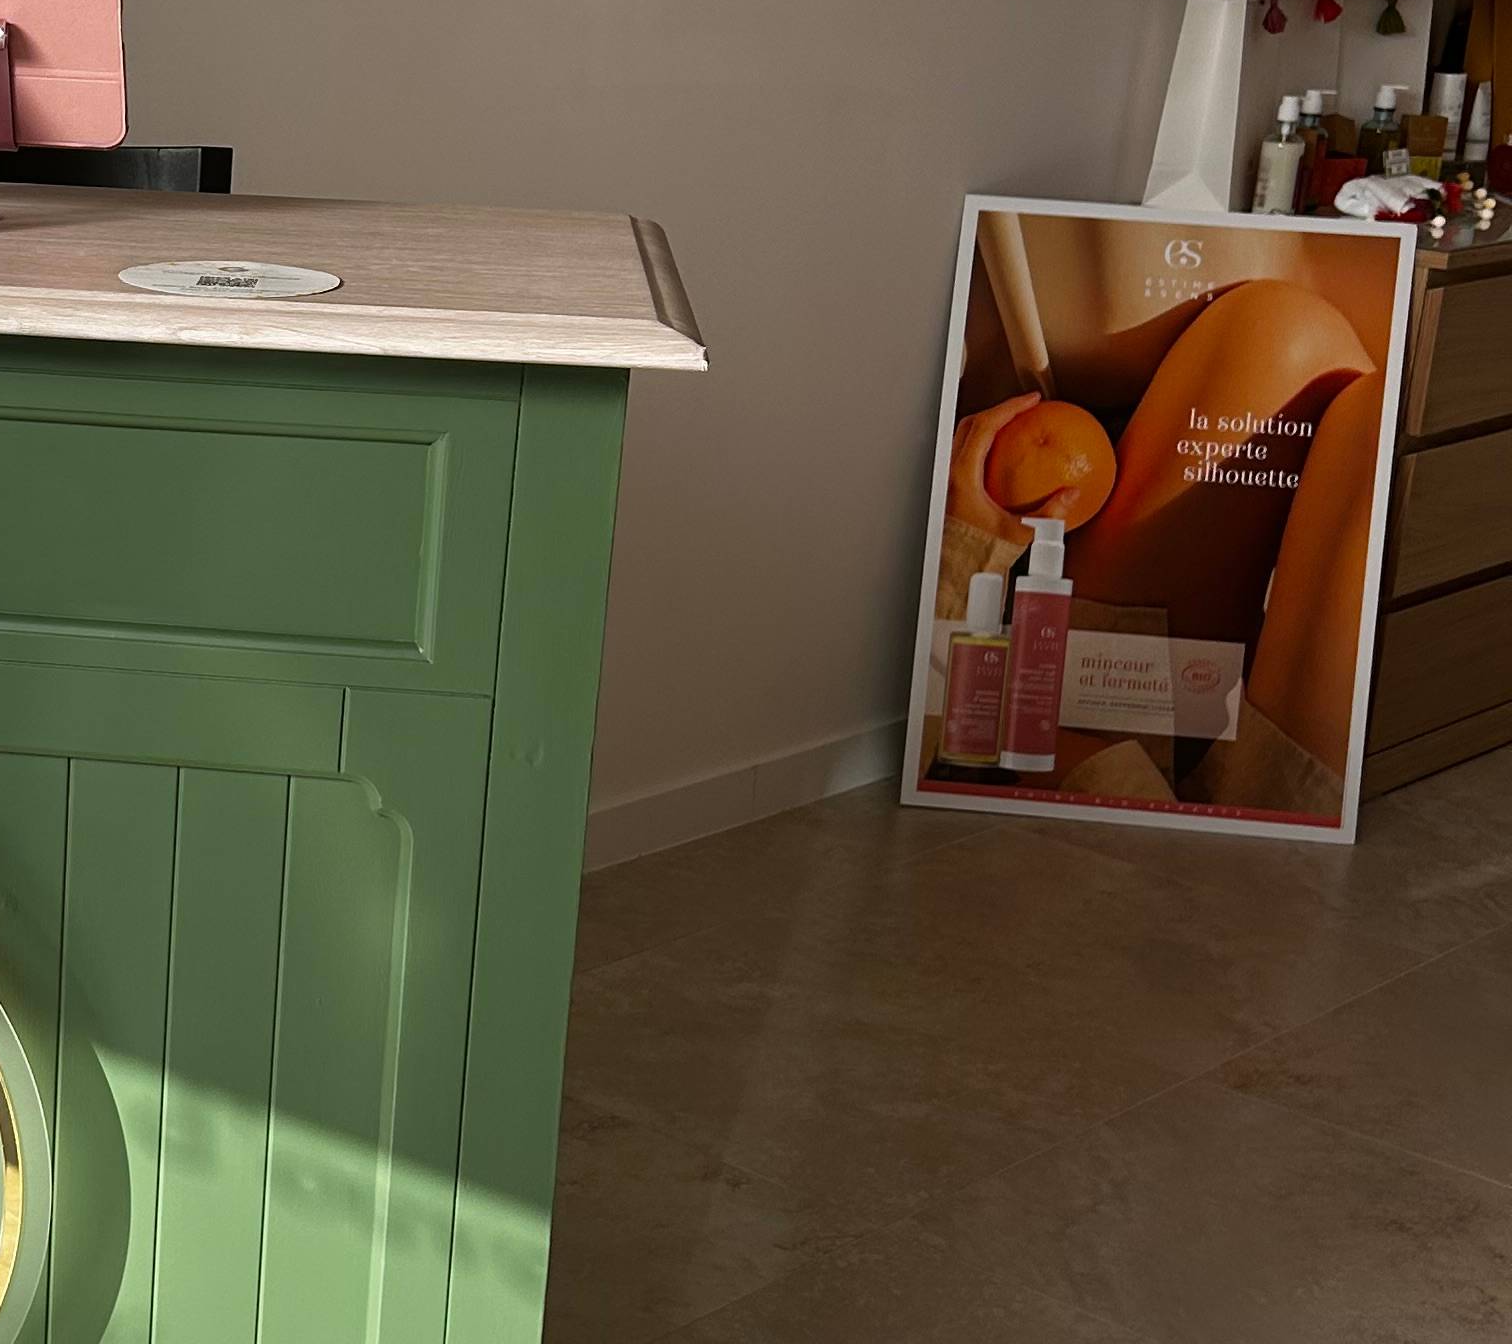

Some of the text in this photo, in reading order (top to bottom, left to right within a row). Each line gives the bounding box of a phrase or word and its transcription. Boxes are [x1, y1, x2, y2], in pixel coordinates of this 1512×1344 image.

[1189, 407, 1313, 438] la solution
[1177, 438, 1268, 461] experte
[1183, 459, 1300, 489] silhouette
[1080, 654, 1154, 673] minceur
[1079, 674, 1169, 693] et fermeté
